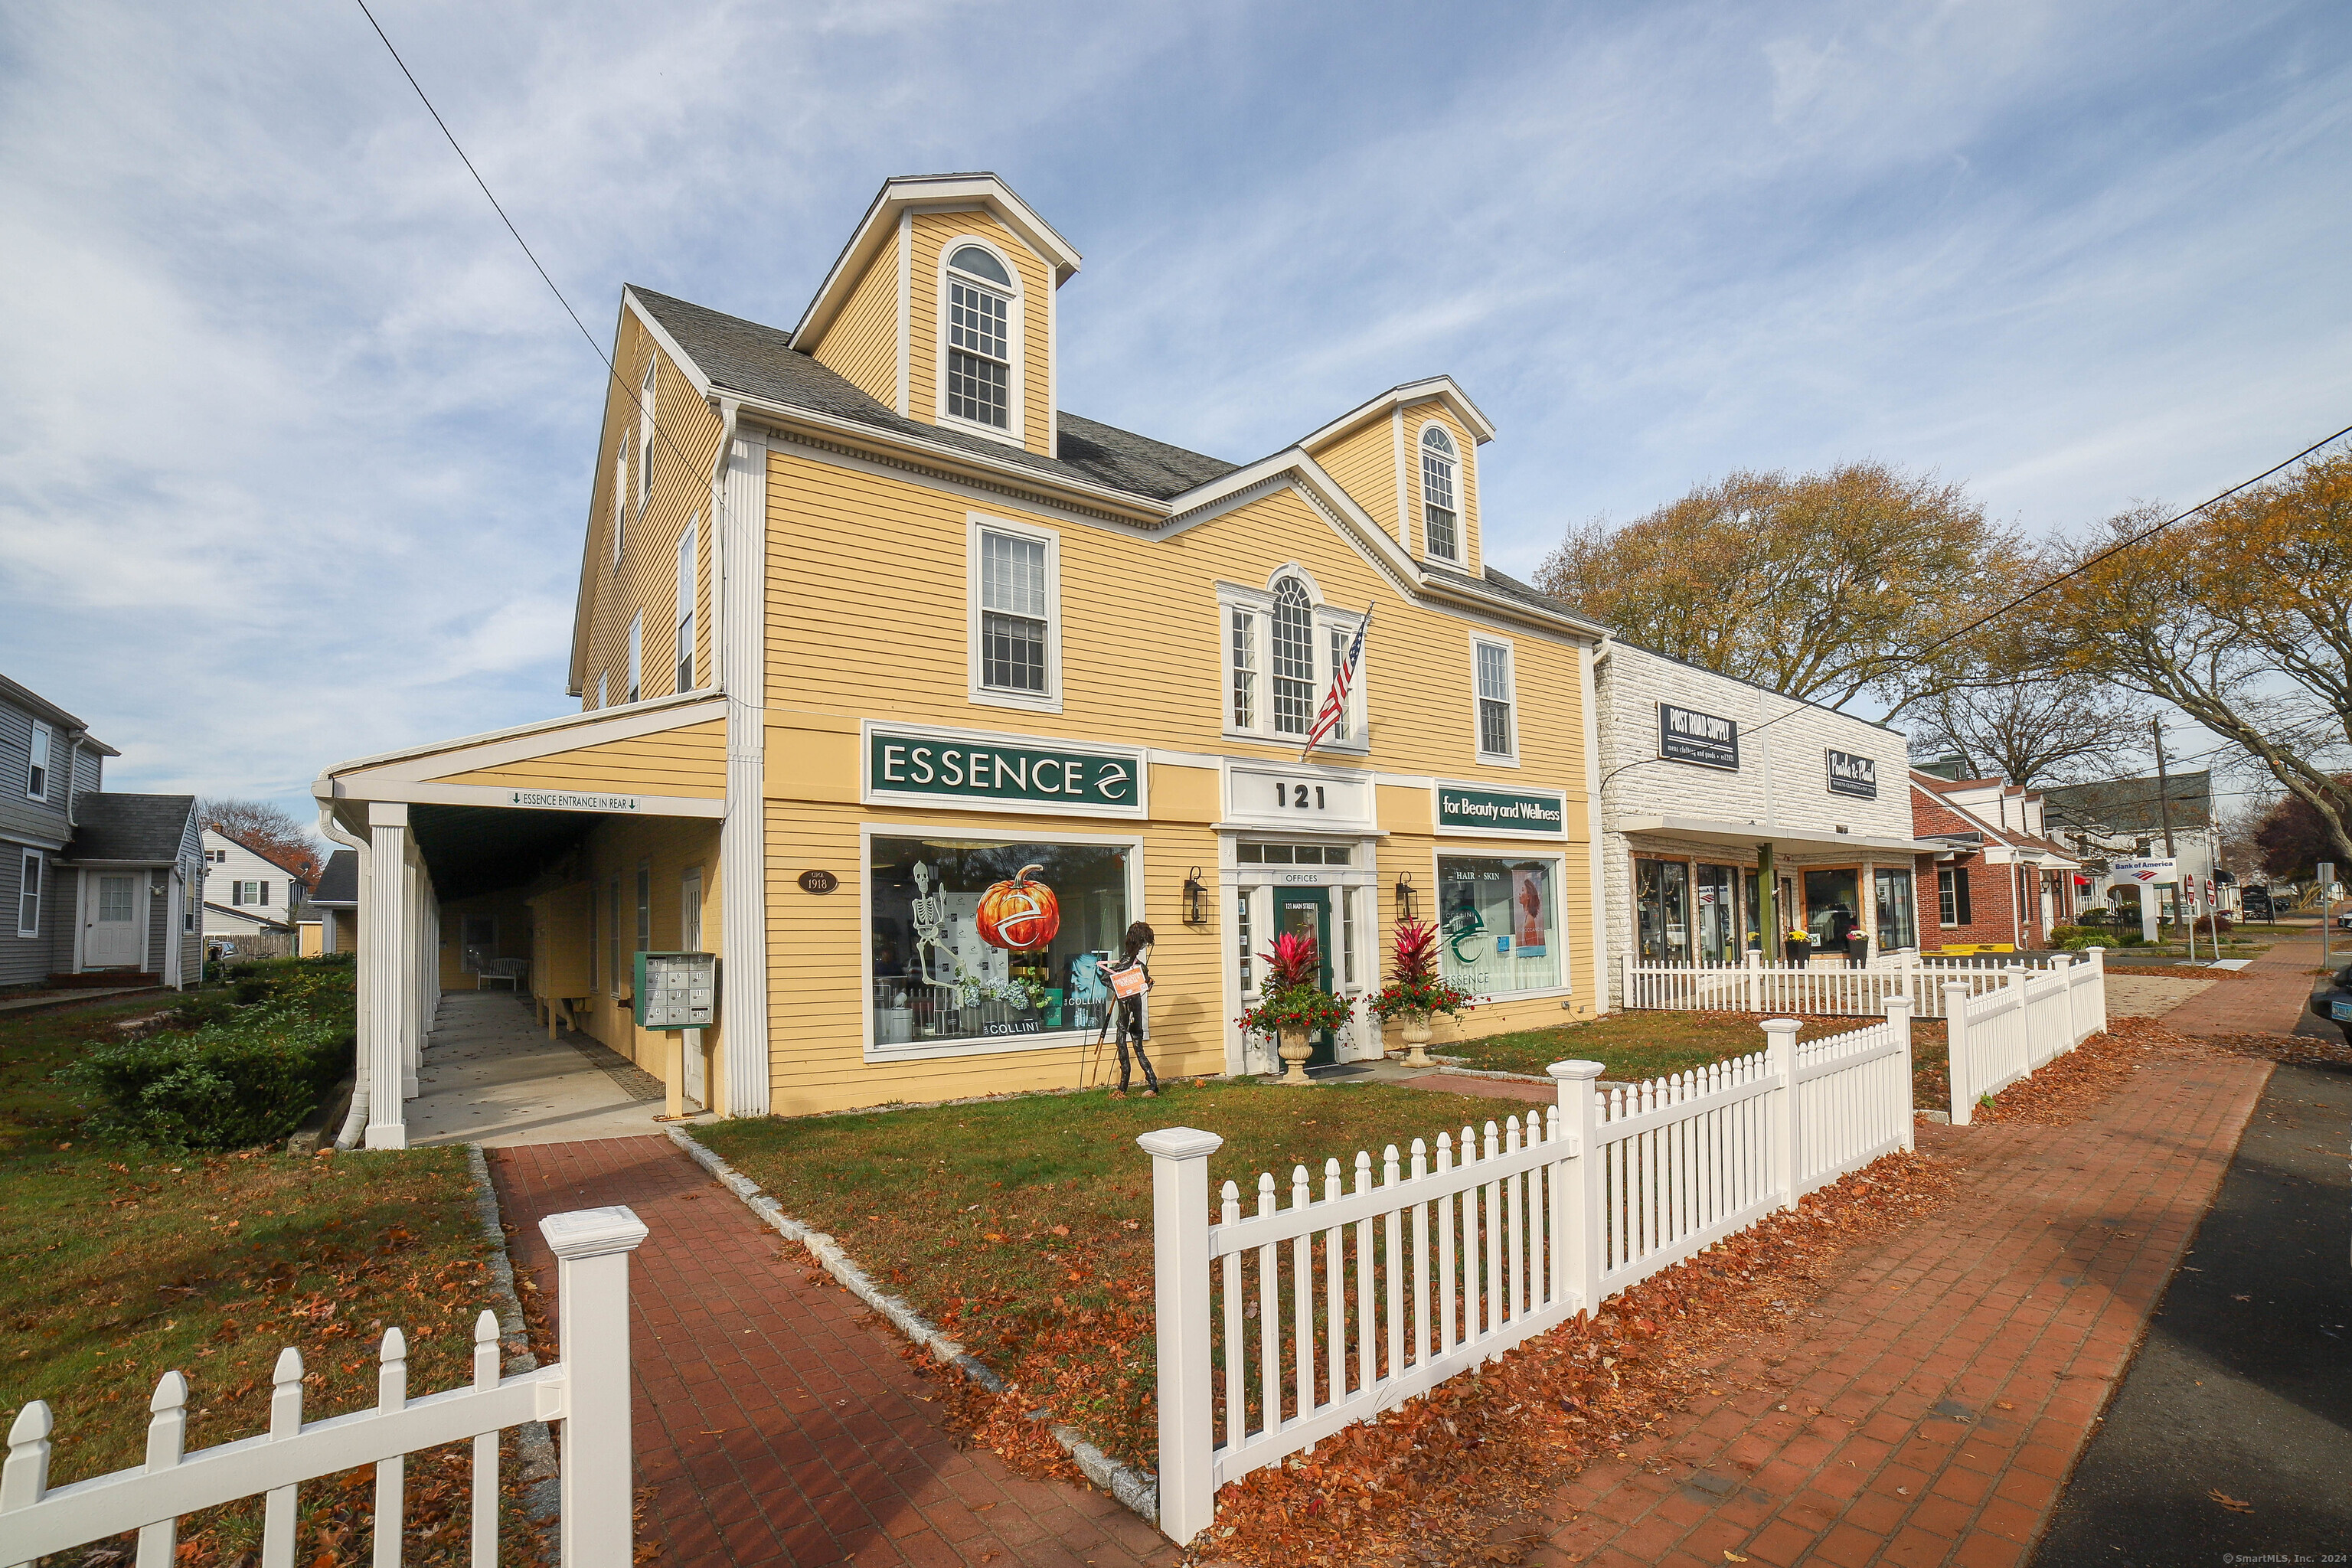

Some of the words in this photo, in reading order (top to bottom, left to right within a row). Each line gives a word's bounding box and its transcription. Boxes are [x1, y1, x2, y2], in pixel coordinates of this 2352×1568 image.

[1670, 707, 1687, 733] POST
[1689, 713, 1707, 737] ROAD
[1707, 717, 1730, 743] SUPPLY
[884, 744, 1083, 795] ESSENCE
[523, 793, 557, 806] ESSENCE
[558, 795, 597, 808] ENTRANCE
[599, 798, 607, 808] IN
[609, 799, 626, 809] REAR
[1276, 782, 1325, 809] 121
[1443, 795, 1460, 814] for
[1461, 798, 1498, 821] Beauty
[1499, 802, 1519, 818] and
[1519, 802, 1560, 821] Wellness
[1285, 874, 1318, 883] OFFICES
[1456, 871, 1475, 880] HAIR
[1483, 871, 1500, 880] SKIN
[808, 878, 828, 889] 1918
[1445, 972, 1489, 986] ESSENCE
[1068, 997, 1102, 1006] COLLIN
[990, 1022, 1035, 1034] COLLIN
